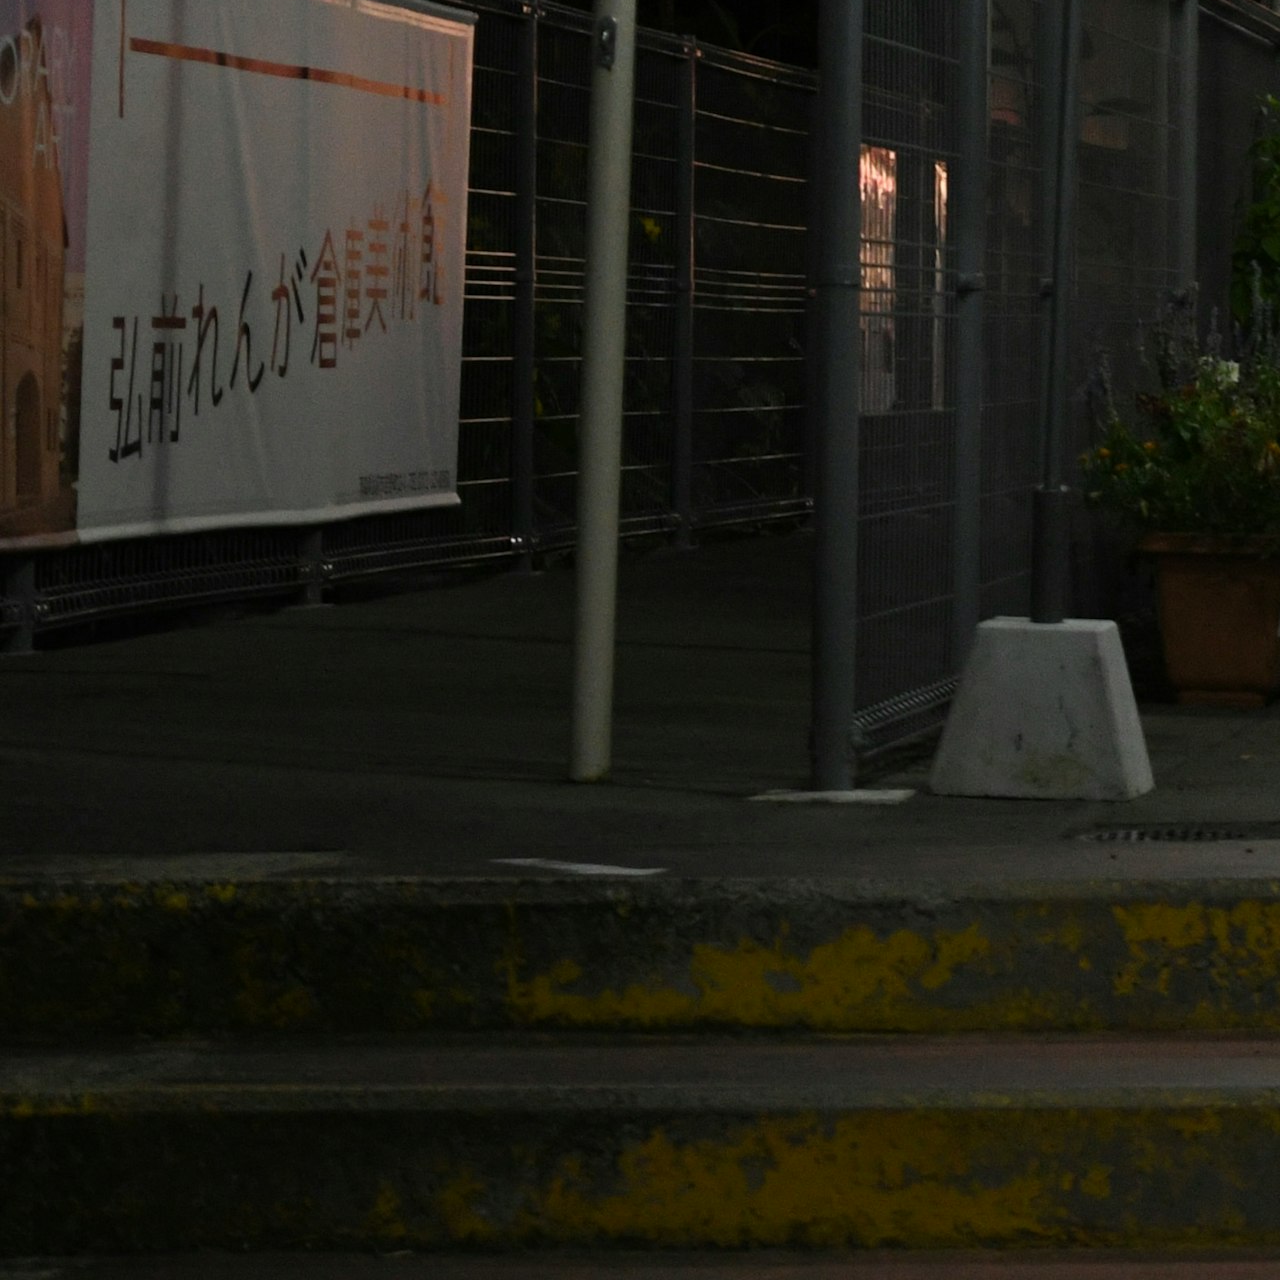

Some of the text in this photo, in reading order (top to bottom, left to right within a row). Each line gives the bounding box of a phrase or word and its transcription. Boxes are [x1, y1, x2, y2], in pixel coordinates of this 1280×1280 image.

[108, 179, 448, 463] 弘前れんが倉庫美術館
